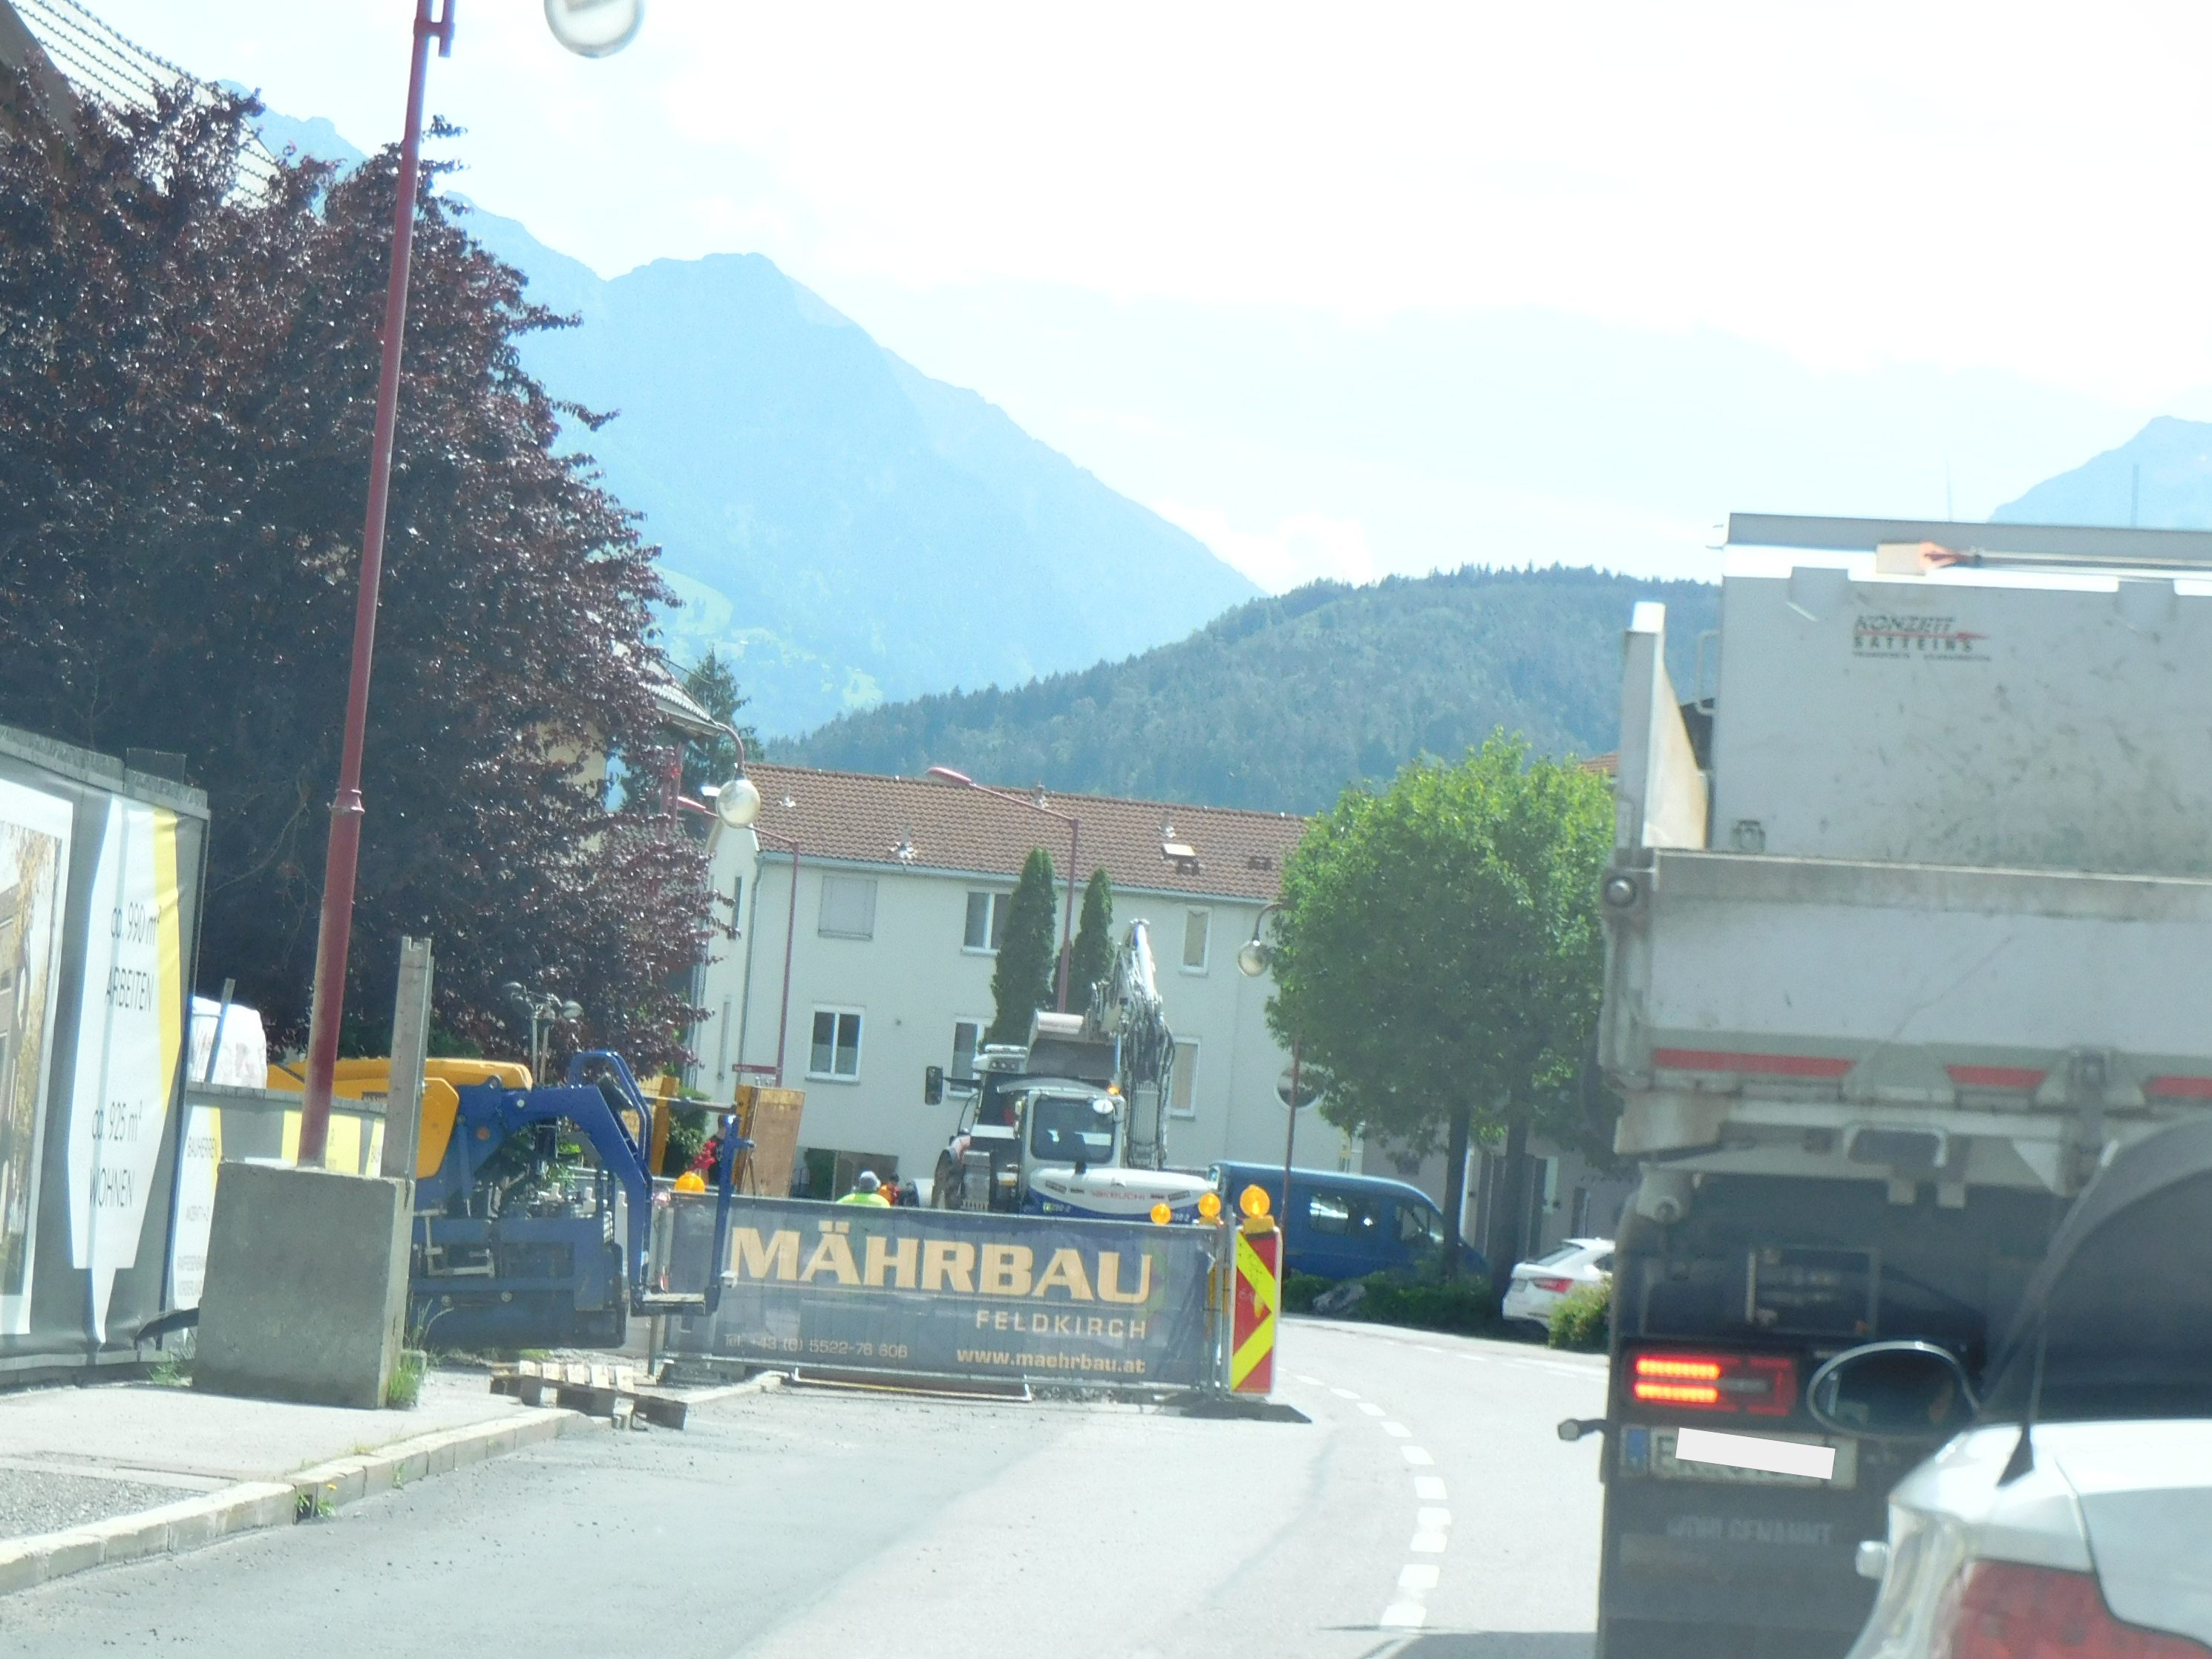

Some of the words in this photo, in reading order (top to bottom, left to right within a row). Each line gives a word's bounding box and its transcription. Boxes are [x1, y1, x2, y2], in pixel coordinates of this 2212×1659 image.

[128, 902, 145, 943] 990
[106, 967, 154, 1012] ARBEITEN
[109, 1101, 125, 1141] 925
[90, 1168, 134, 1208] WOHNEN
[730, 1220, 1152, 1303] MÄHRBAU
[975, 1309, 1146, 1340] FELDKIRCH
[956, 1349, 1146, 1374] www.maehrbau.at
